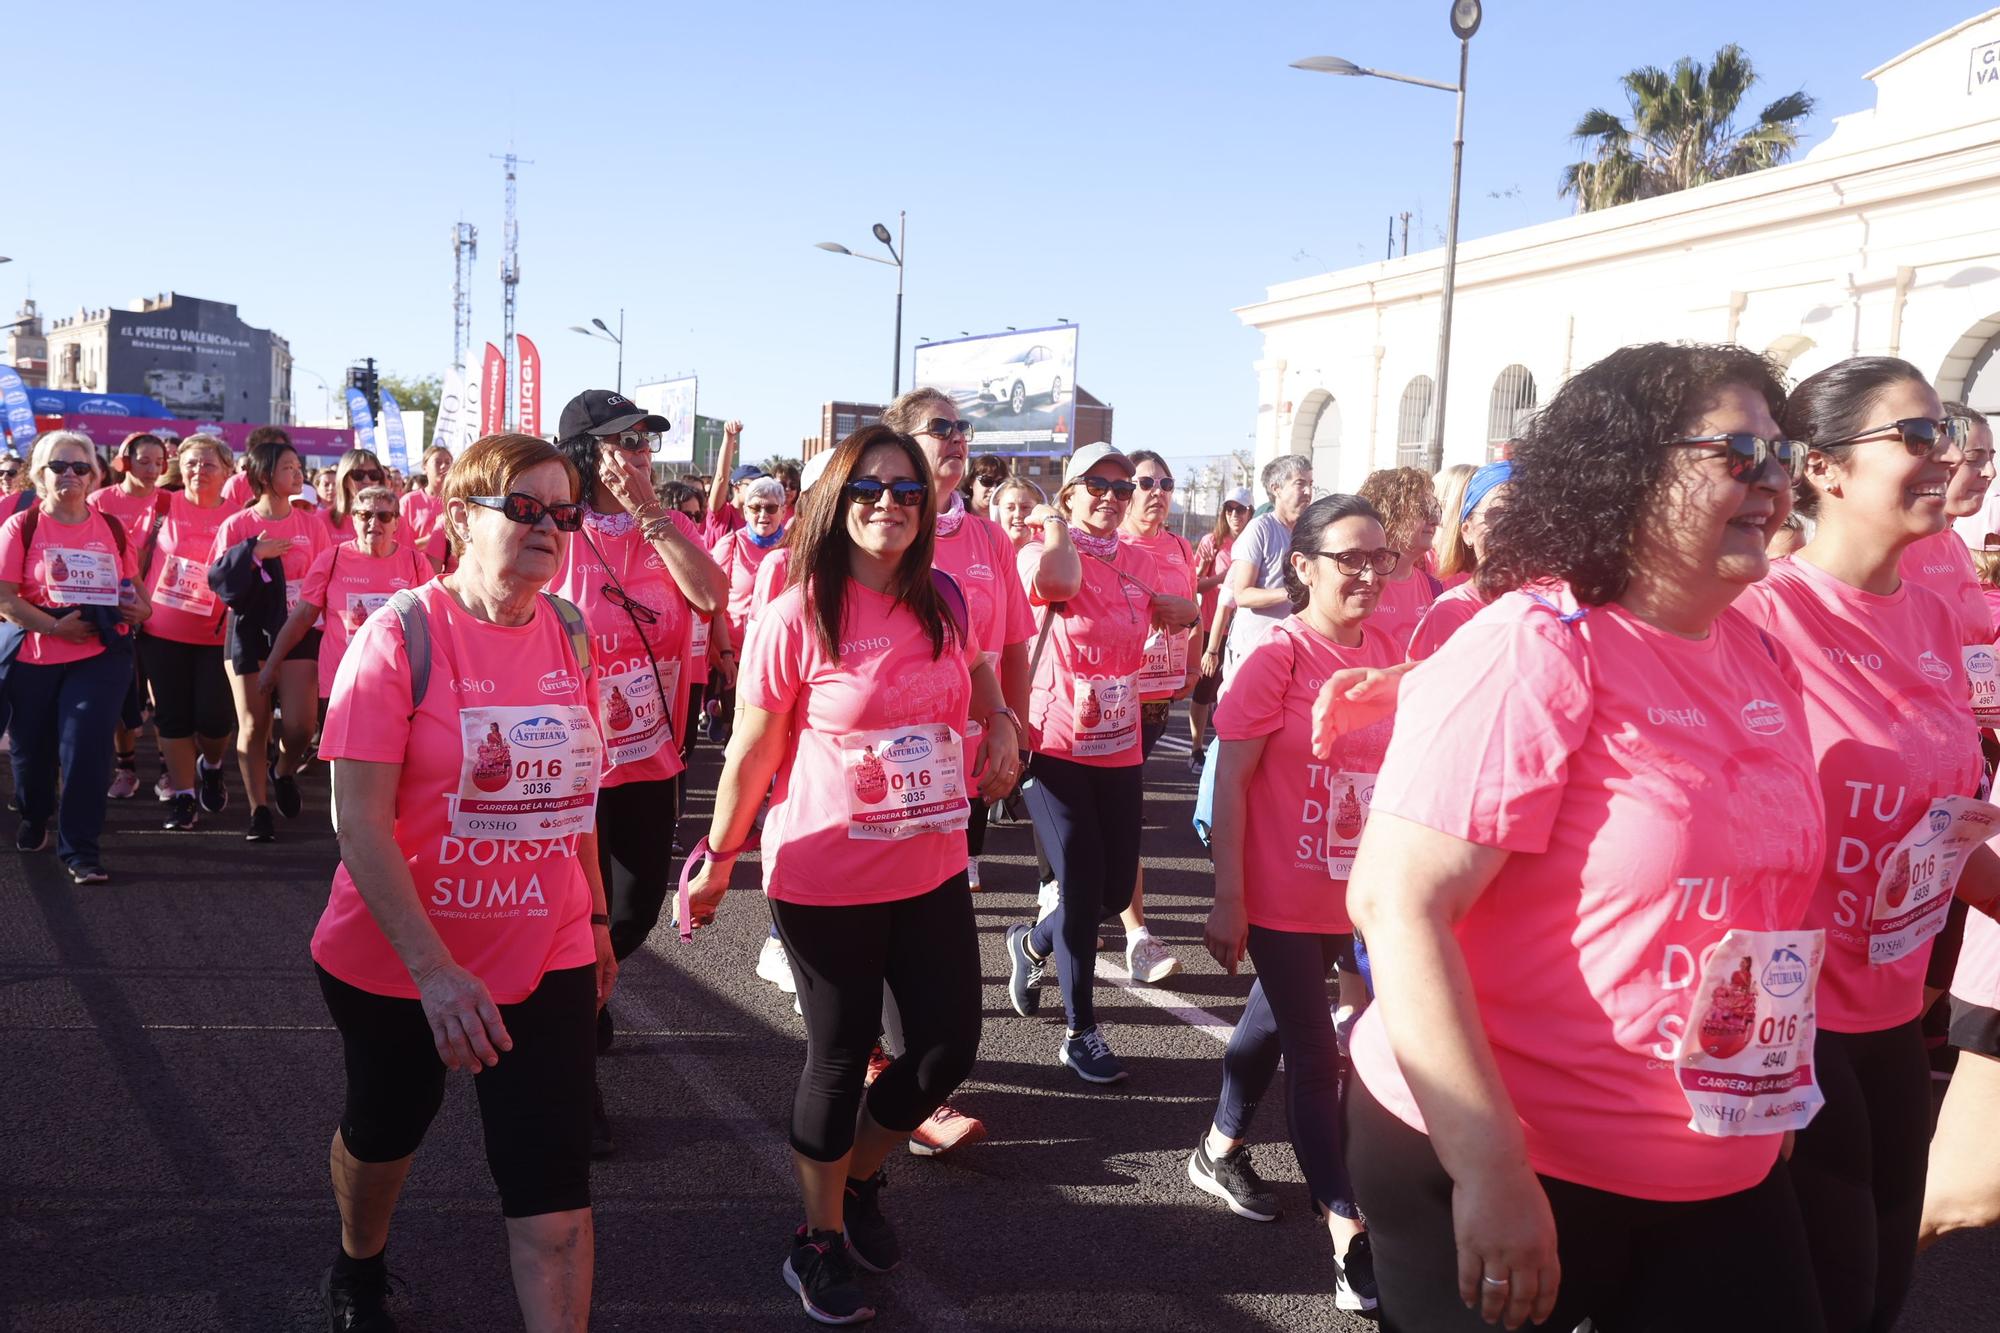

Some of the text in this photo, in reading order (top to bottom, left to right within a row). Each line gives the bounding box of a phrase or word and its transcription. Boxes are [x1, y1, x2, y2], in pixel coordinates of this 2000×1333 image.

[121, 326, 134, 337] EL
[136, 326, 178, 341] PUERTO
[70, 569, 95, 579] 016
[577, 565, 617, 575] OYSHO
[178, 578, 198, 590] 016
[1076, 645, 1100, 665] TU
[1975, 681, 1996, 694] 016
[1103, 706, 1126, 720] 016
[570, 722, 592, 731] SUMA
[514, 728, 567, 741] ASTURIANA
[935, 733, 951, 744] SUM
[616, 745, 647, 758] OYSHO
[886, 745, 930, 759] ASTURIANA
[516, 758, 562, 779] 016
[891, 769, 932, 790] 016
[522, 782, 552, 796] 3036
[900, 791, 926, 804] 3035
[1845, 780, 1905, 822] TU
[476, 803, 518, 812] CARRERA
[520, 802, 530, 810] DE
[532, 801, 542, 810] LA
[865, 812, 900, 822] CARRERA
[901, 809, 912, 817] DE
[912, 807, 922, 816] LA
[922, 803, 945, 814] MUJER
[469, 819, 517, 832] OYSHO
[1958, 814, 1992, 827] SUMA
[862, 824, 901, 835] OYSHO
[1911, 854, 1935, 885] 016
[430, 873, 545, 908] SUMA
[1676, 876, 1730, 922] TU
[428, 908, 467, 919] CARRERA
[469, 912, 481, 920] DE
[481, 911, 492, 920] LA
[527, 908, 549, 917] 2023
[1758, 1013, 1798, 1045] 016
[1761, 1051, 1787, 1069] 4940
[1697, 1075, 1754, 1091] CARRERA
[1698, 1102, 1747, 1123] OYSHO
